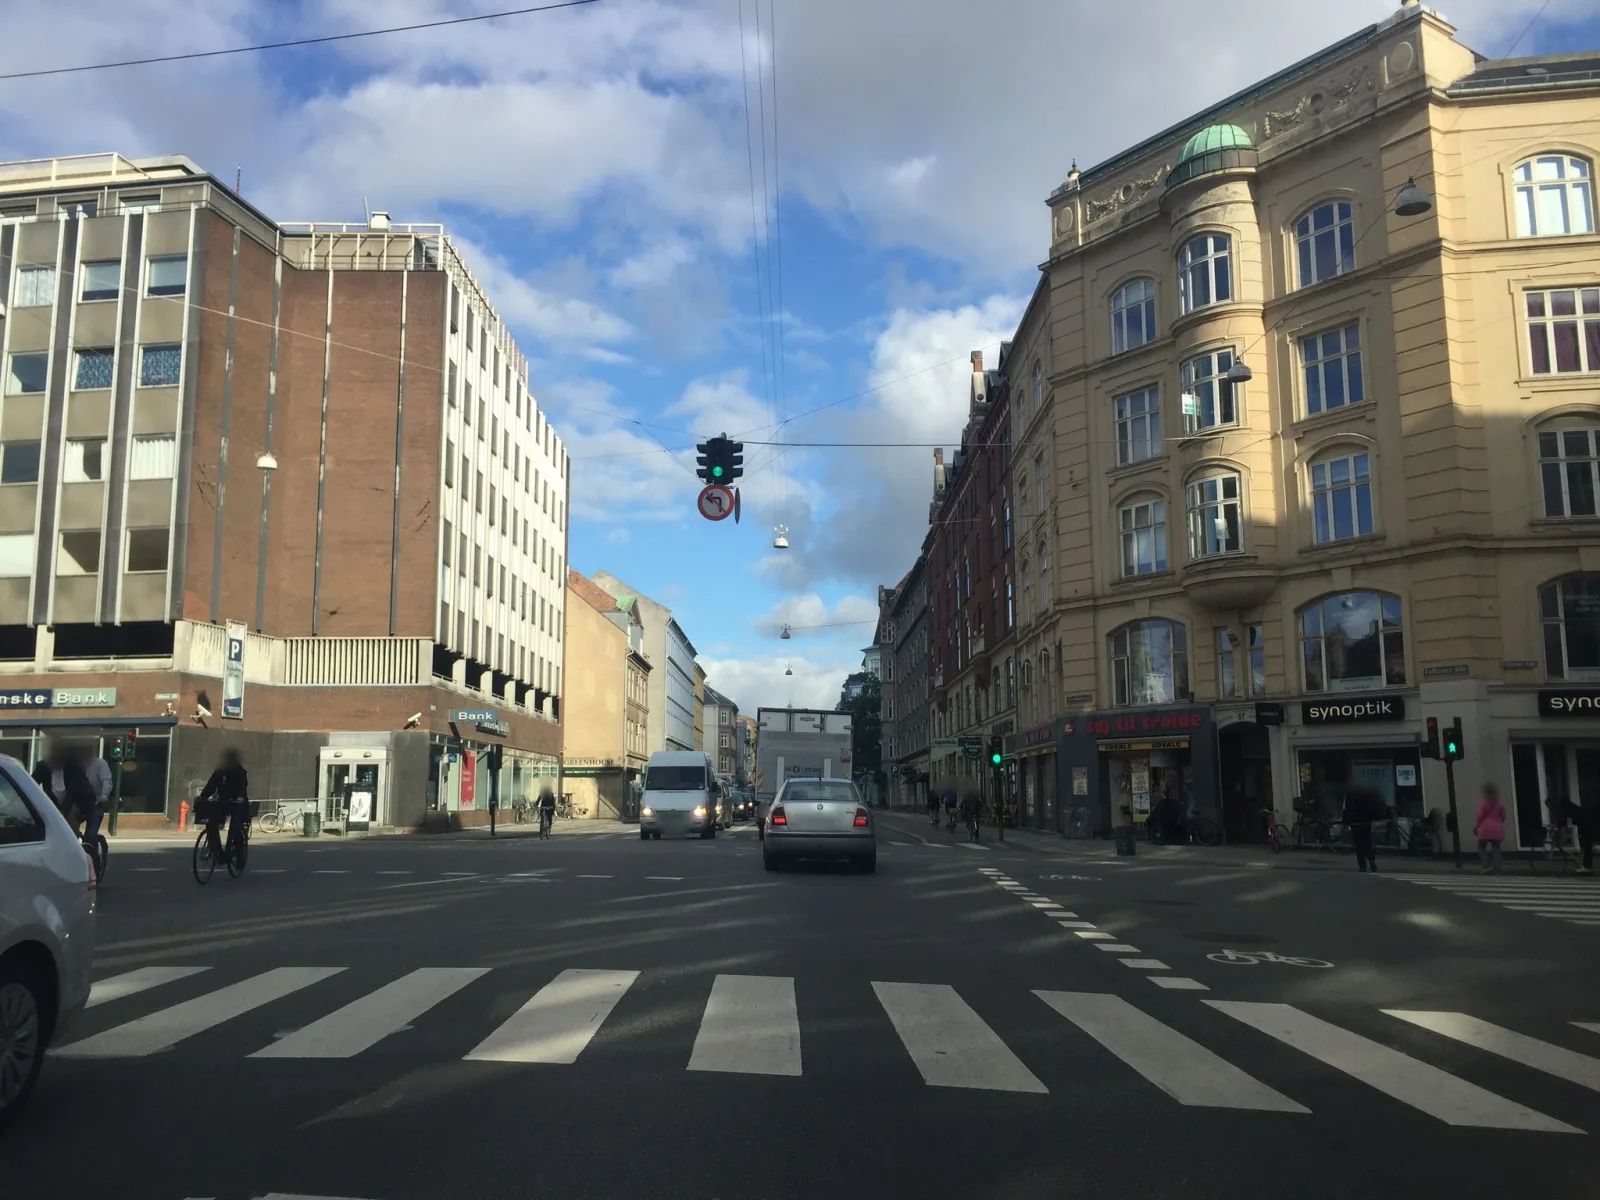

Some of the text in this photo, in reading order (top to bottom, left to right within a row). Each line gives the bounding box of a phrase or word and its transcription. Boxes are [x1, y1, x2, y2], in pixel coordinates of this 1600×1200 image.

[231, 640, 240, 659] P
[56, 692, 108, 705] Bank
[458, 711, 493, 720] Bank
[1309, 700, 1393, 720] synoptik
[564, 758, 614, 766] GREENHOUSE
